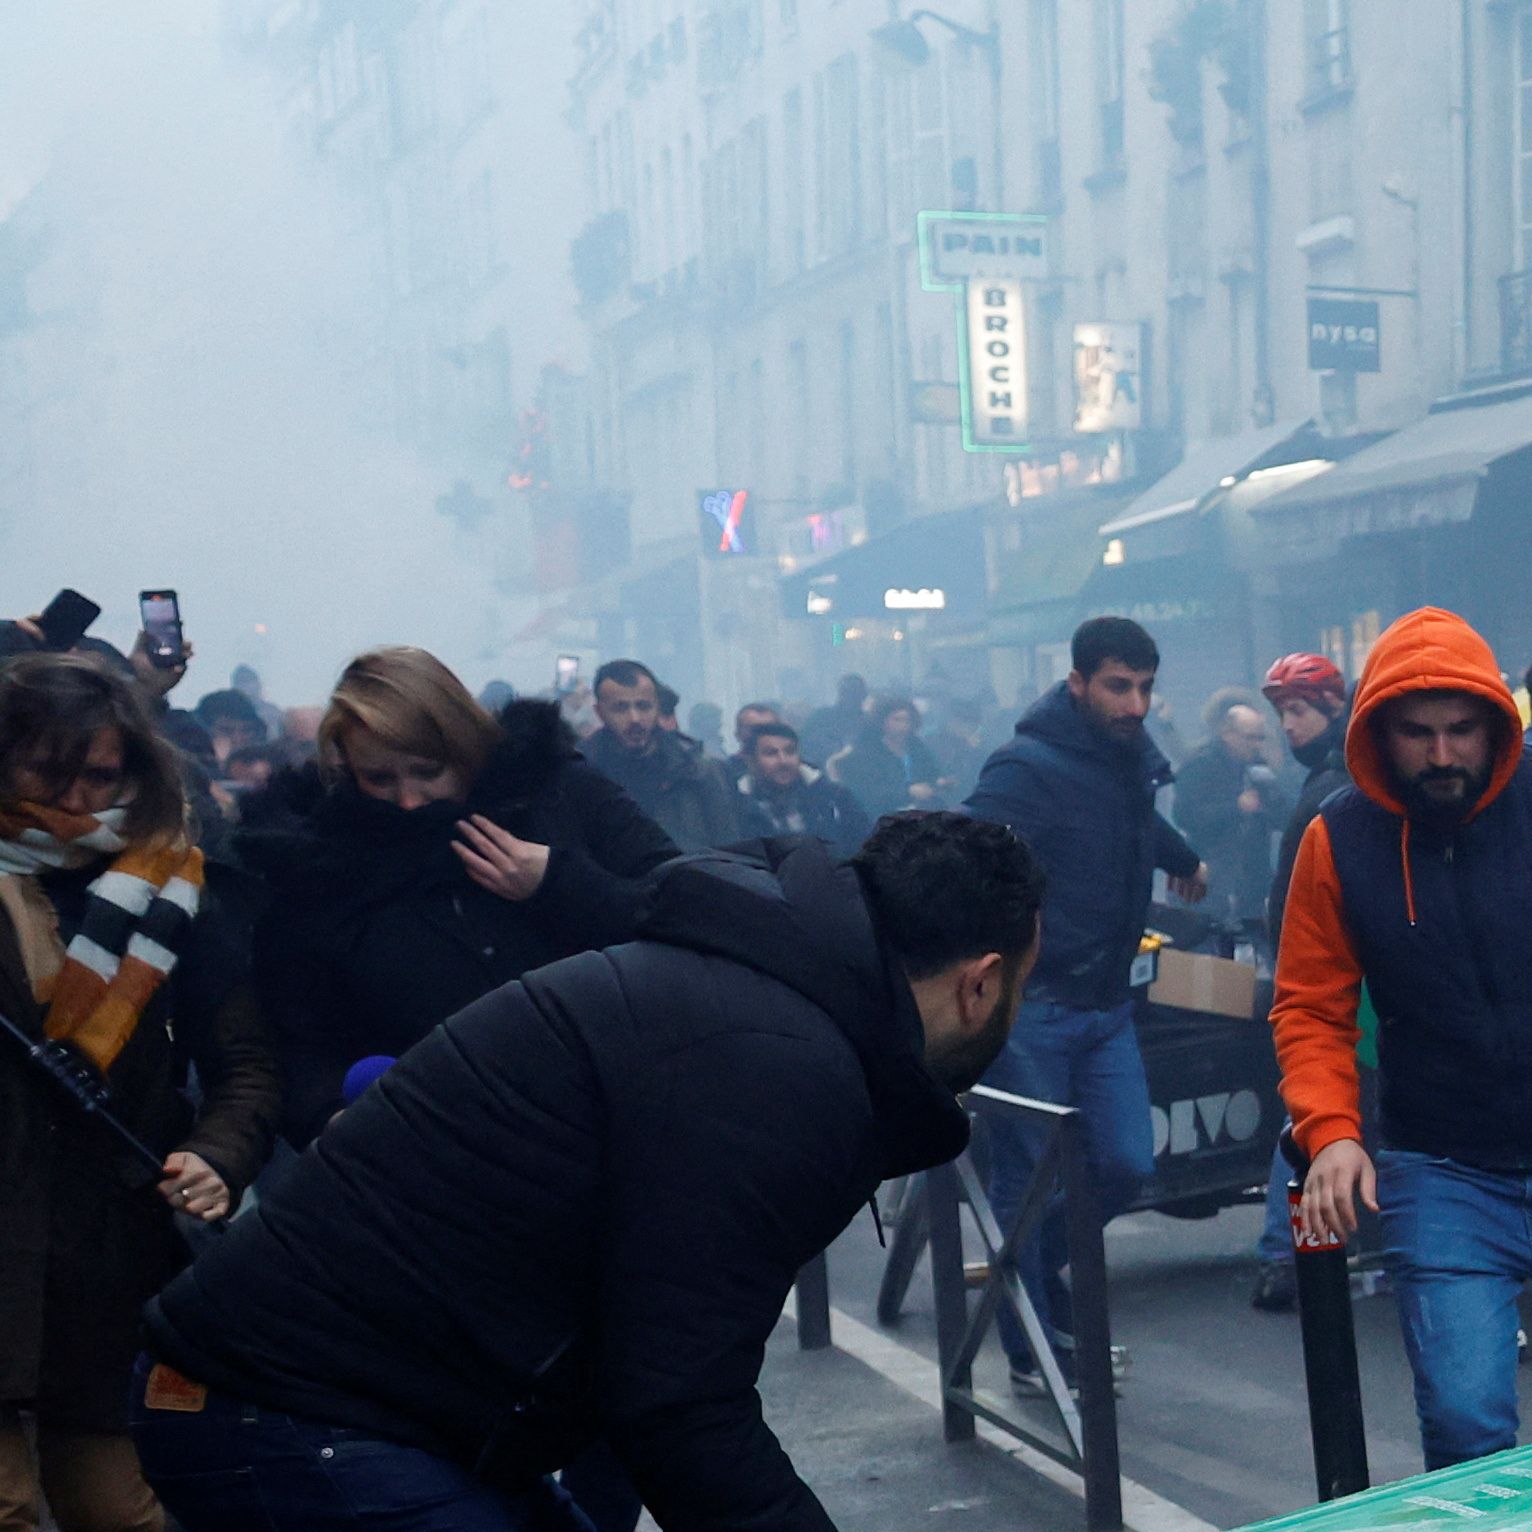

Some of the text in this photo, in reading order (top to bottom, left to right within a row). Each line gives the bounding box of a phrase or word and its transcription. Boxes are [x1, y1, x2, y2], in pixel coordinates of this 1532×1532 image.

[942, 233, 1042, 256] PAIN
[1311, 323, 1377, 346] nysa
[983, 288, 1015, 435] BROCHE
